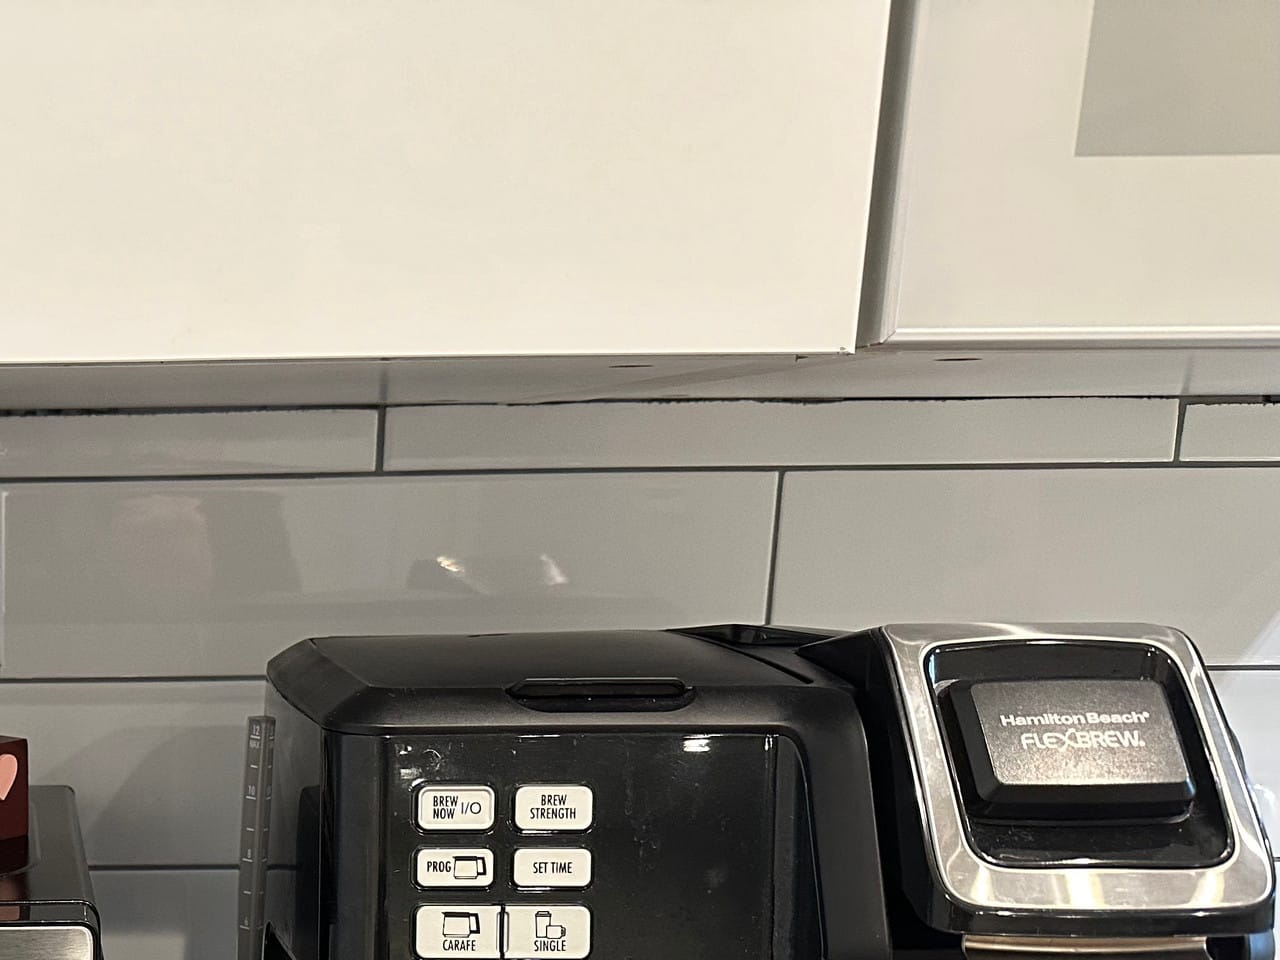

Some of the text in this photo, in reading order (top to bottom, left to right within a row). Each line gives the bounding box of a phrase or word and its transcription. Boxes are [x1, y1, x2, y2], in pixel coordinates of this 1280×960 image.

[1000, 713, 1086, 726] Hamilton
[433, 796, 458, 807] BREW
[541, 794, 567, 806] BREW
[433, 808, 455, 820] NOW
[529, 808, 577, 819] STRENGTH
[426, 861, 452, 872] PROG
[532, 862, 573, 874] SET TIME
[442, 939, 476, 951] CARAFE
[534, 940, 567, 951] SINGLE
